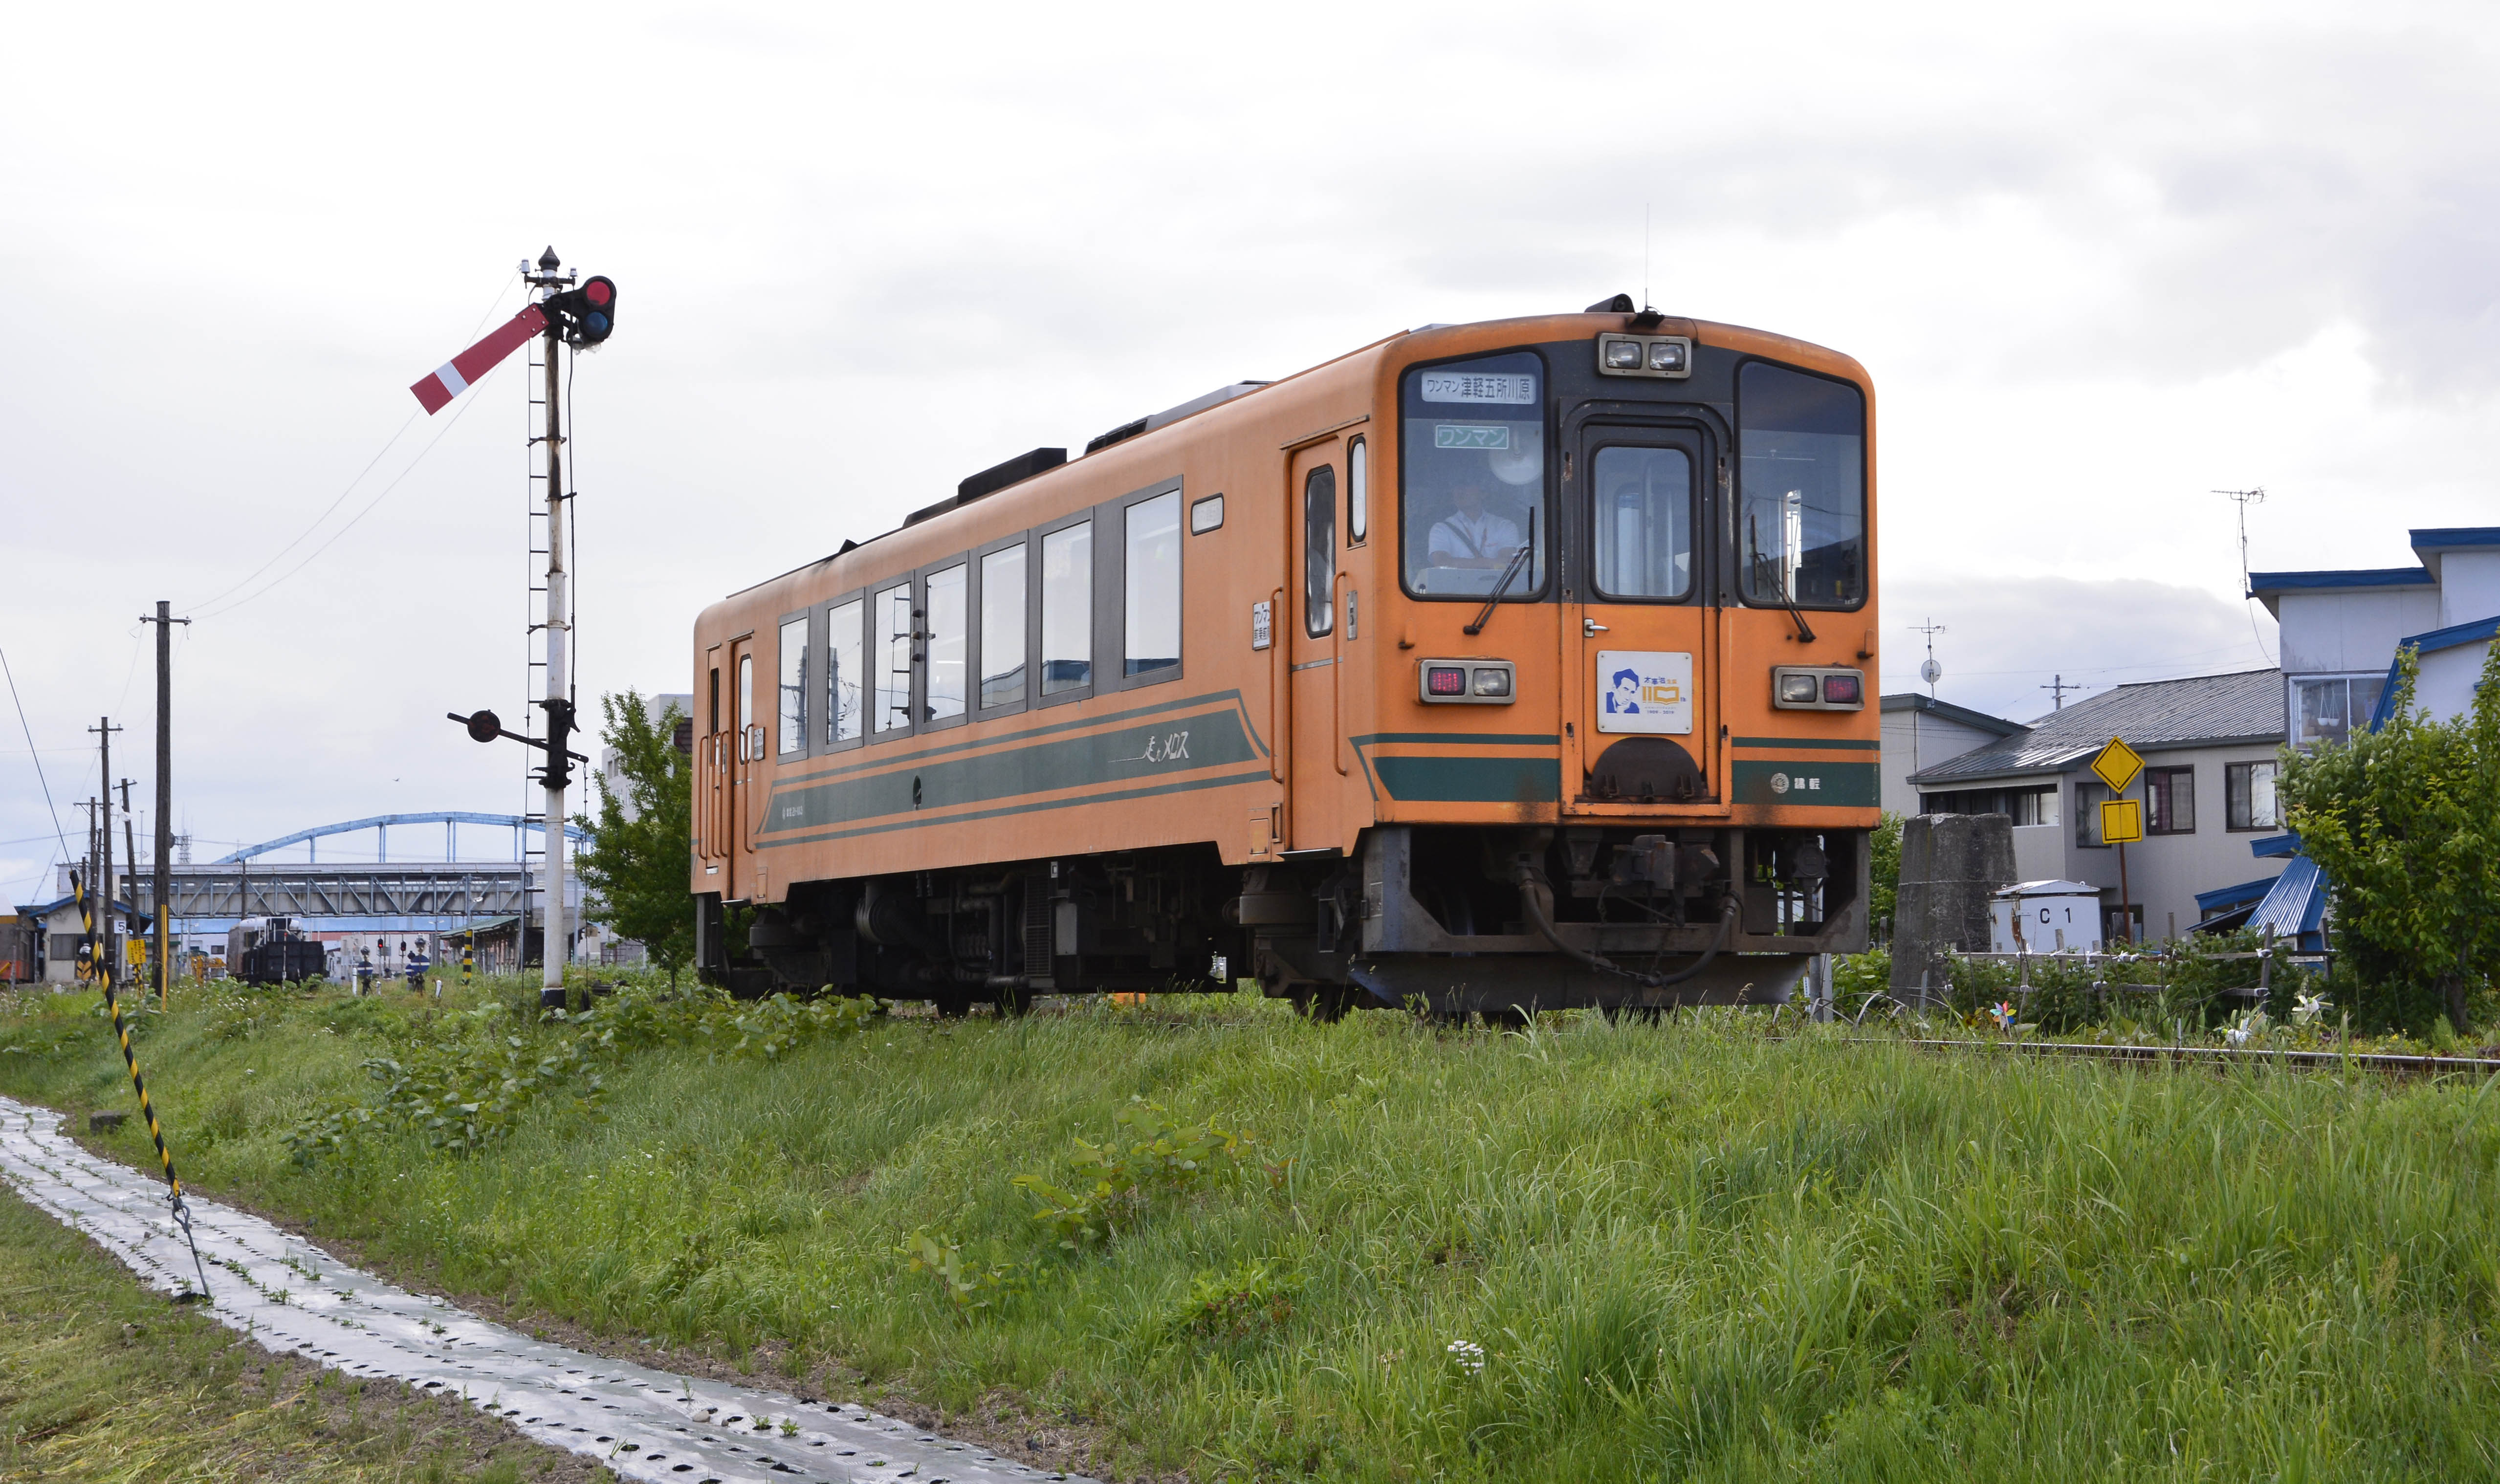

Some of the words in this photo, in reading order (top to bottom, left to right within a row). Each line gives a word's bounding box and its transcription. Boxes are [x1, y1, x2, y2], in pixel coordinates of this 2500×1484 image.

[1427, 379, 1460, 393] ワンマン
[1461, 377, 1530, 400] 津軽五所川原
[1439, 428, 1506, 446] ワンマン
[2039, 908, 2050, 924] C
[2064, 907, 2071, 923] 1
[118, 921, 125, 932] 5
